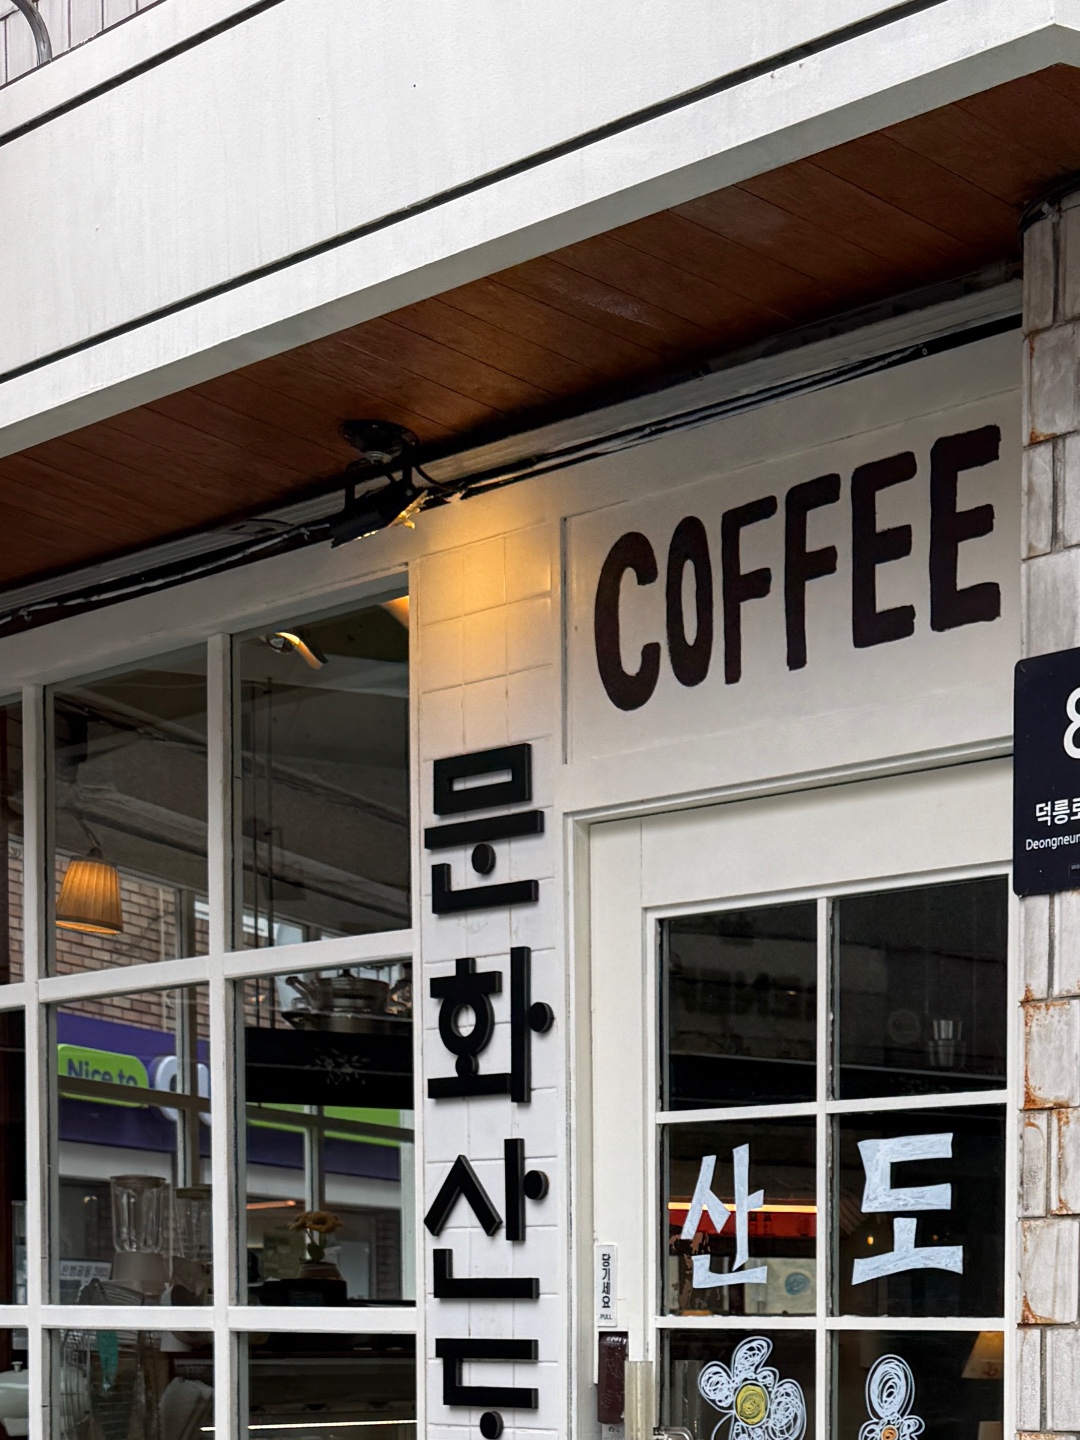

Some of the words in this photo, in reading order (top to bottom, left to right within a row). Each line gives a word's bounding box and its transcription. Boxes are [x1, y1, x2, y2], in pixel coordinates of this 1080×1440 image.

[594, 424, 1002, 712] COFFEE
[601, 1253, 612, 1309] 당기세요
[600, 1313, 613, 1321] PULL
